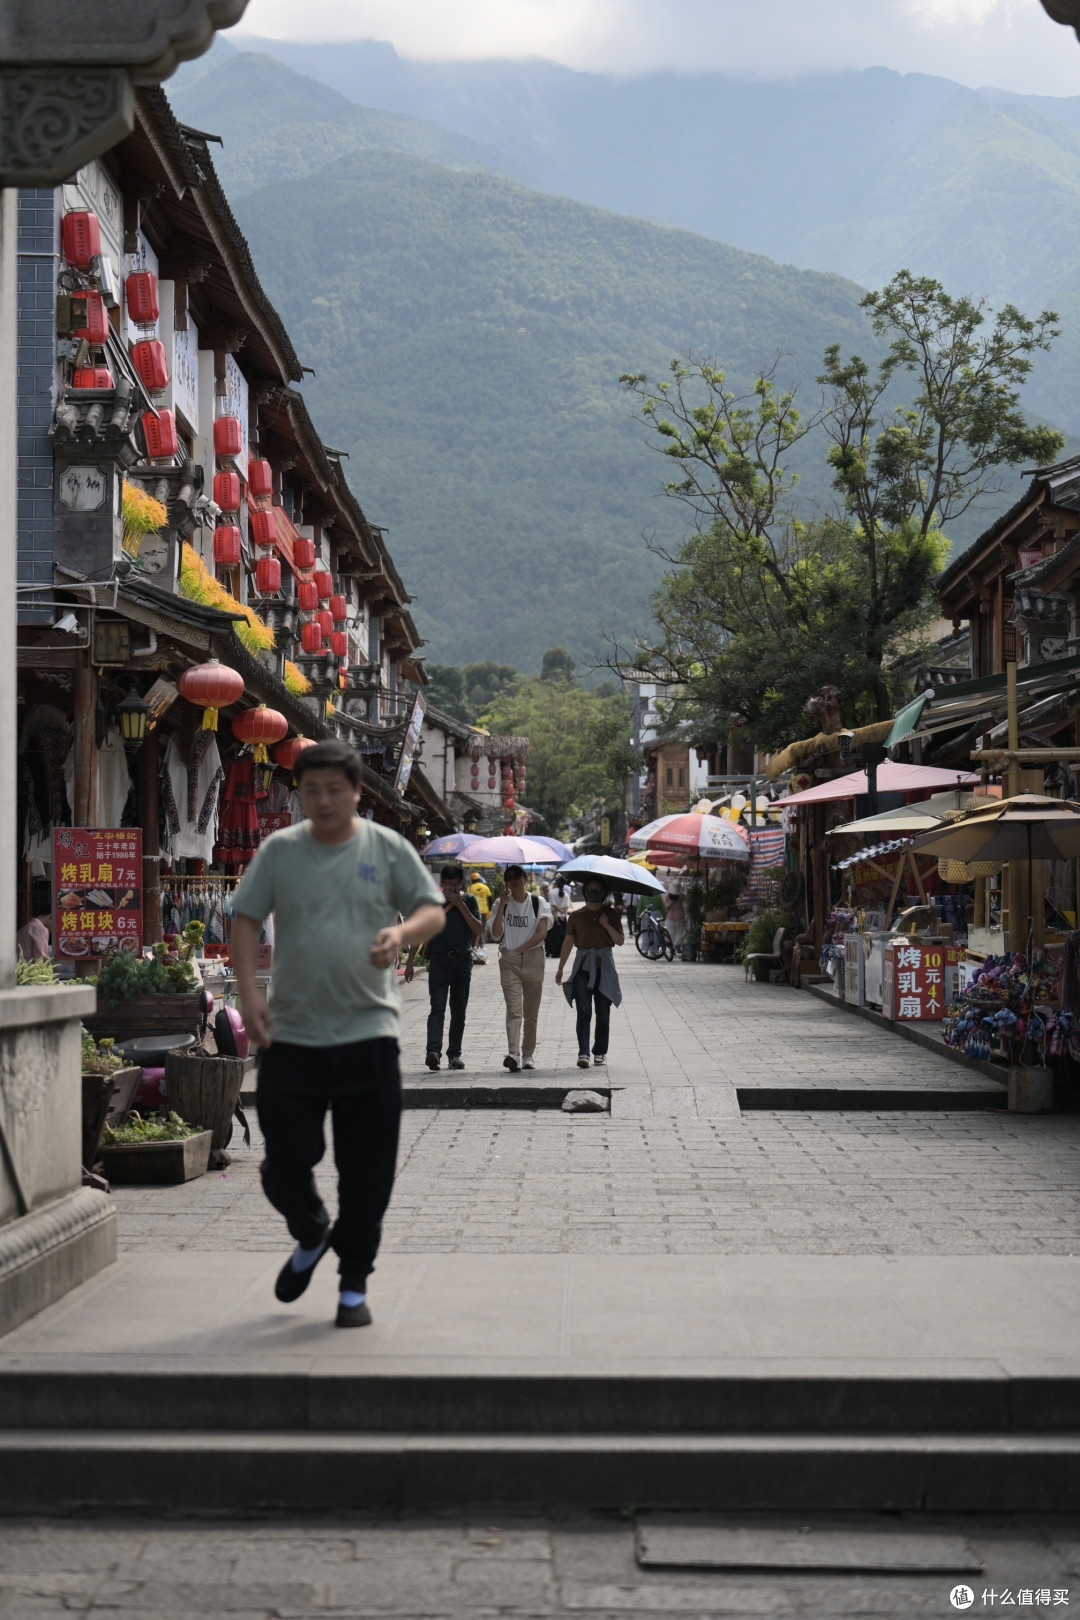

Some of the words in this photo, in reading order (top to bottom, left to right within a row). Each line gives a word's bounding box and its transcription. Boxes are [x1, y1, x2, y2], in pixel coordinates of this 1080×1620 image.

[96, 842, 136, 850] 三十年老店
[61, 863, 113, 882] 烤乳扇
[116, 868, 136, 880] 7元
[61, 911, 114, 931] 烤饵块
[117, 917, 137, 929] 6元
[947, 950, 966, 962] 建水
[897, 947, 922, 1018] 烤乳扇
